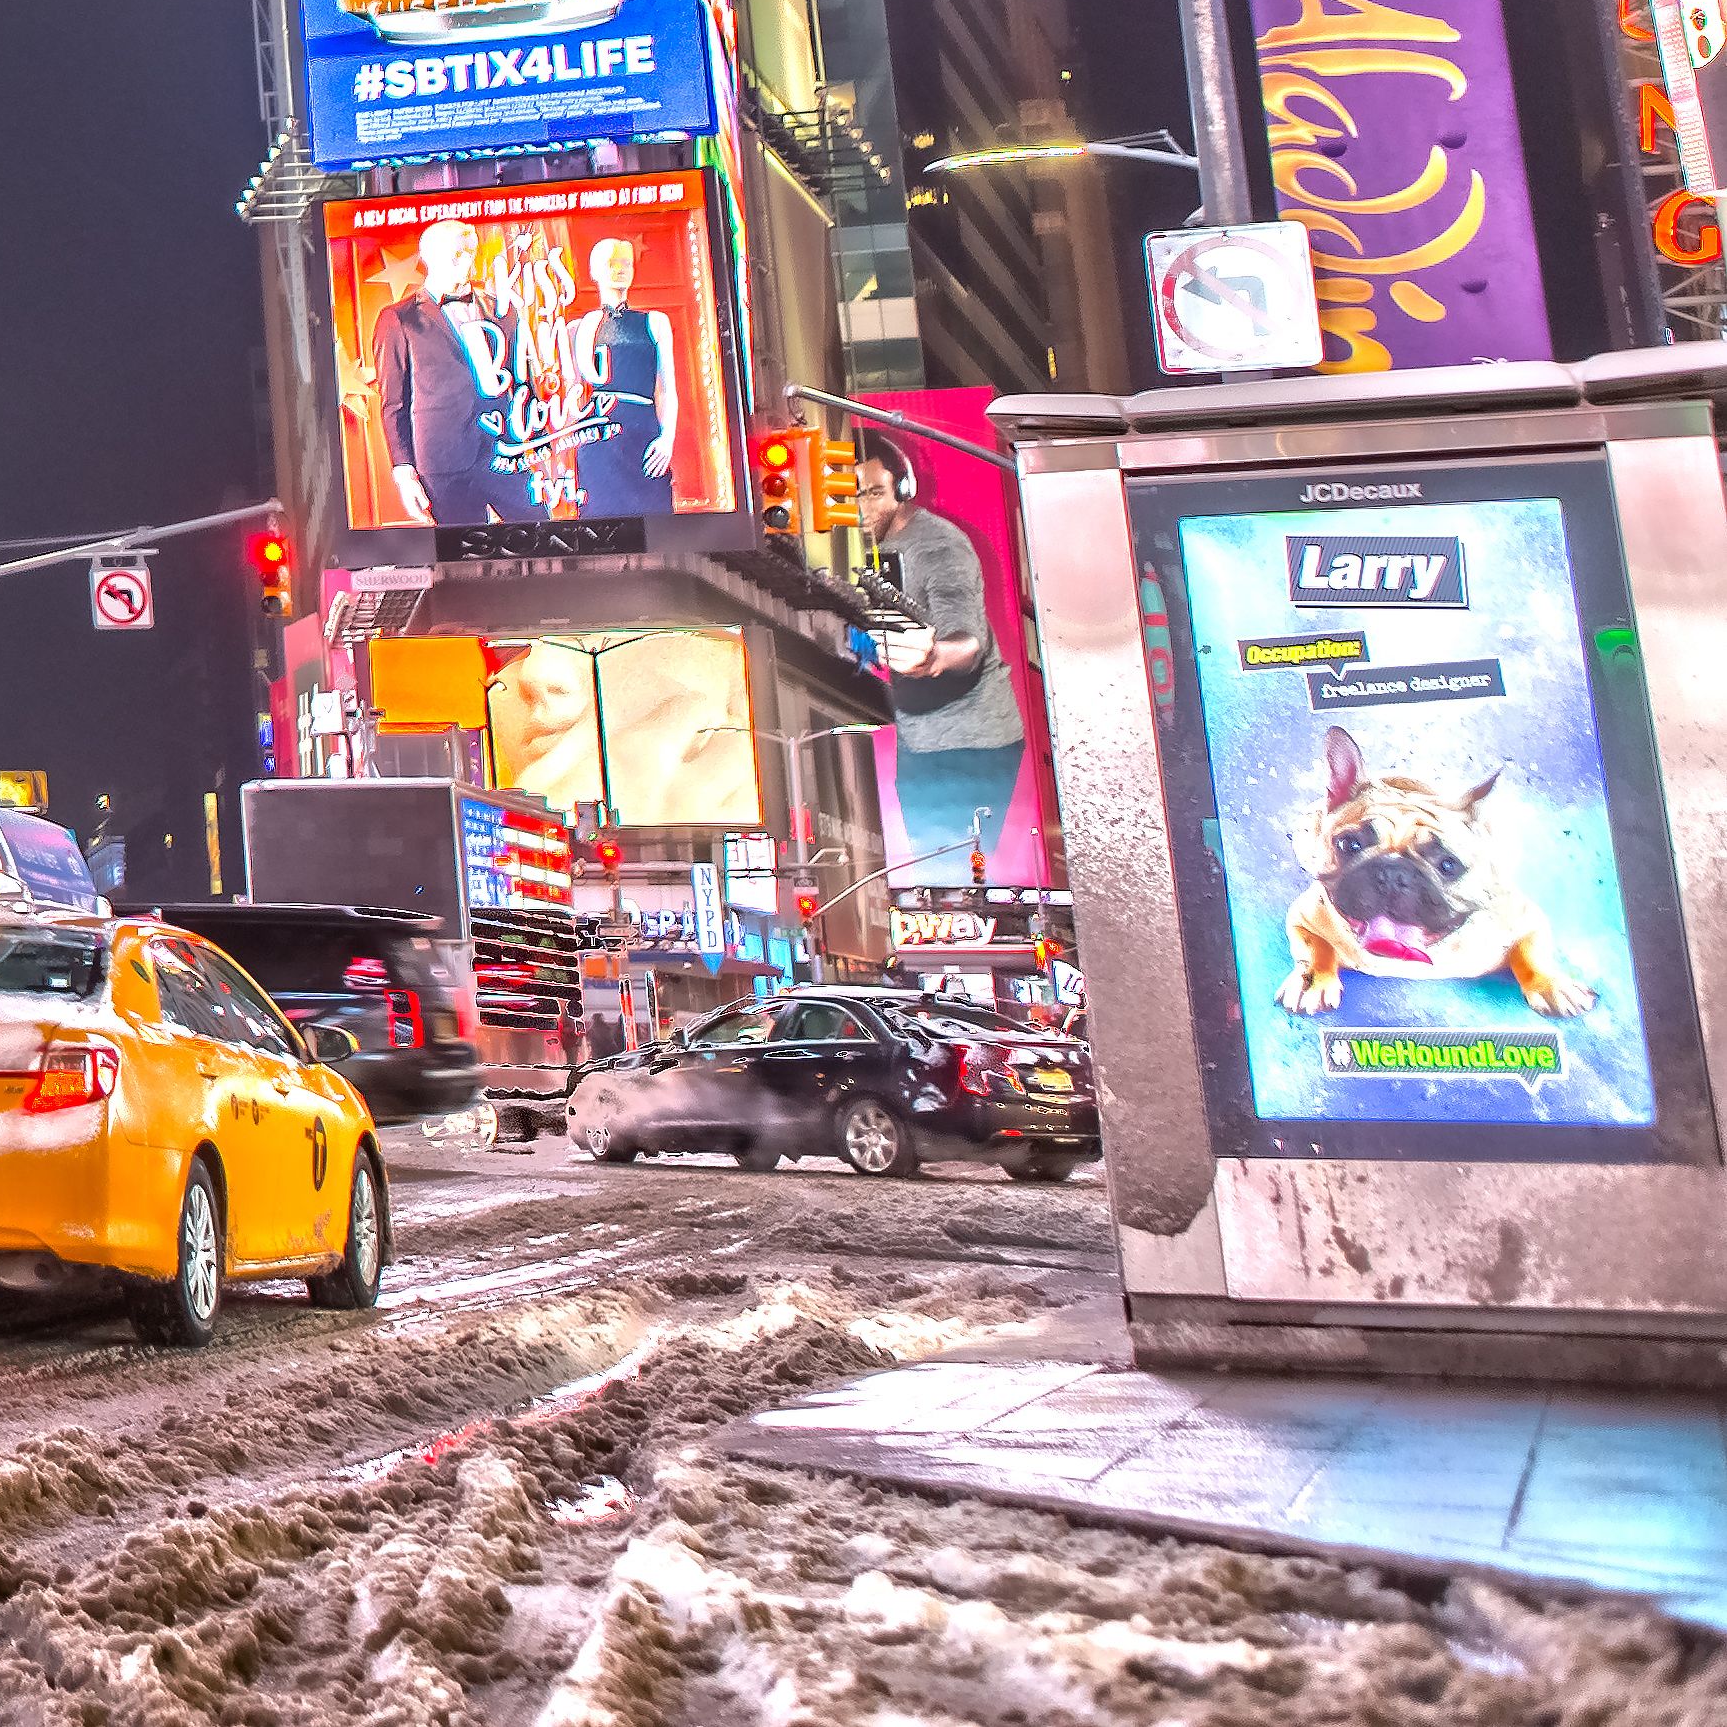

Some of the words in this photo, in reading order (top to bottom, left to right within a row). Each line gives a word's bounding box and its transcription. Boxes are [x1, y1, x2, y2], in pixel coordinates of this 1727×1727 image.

[353, 34, 657, 103] #SBTIX4LIFE
[492, 245, 578, 319] KISS
[460, 315, 611, 400] BANG
[1299, 480, 1423, 506] JCDecaux
[460, 521, 625, 560] SONY
[355, 573, 430, 587] SHERWOOD
[1296, 542, 1449, 601] Larry
[1246, 638, 1362, 664] Occupation:
[1321, 678, 1408, 699] freelance
[1409, 672, 1493, 696] designer
[698, 867, 719, 949] NYPD
[1327, 1037, 1556, 1073] #WeHoundLove
